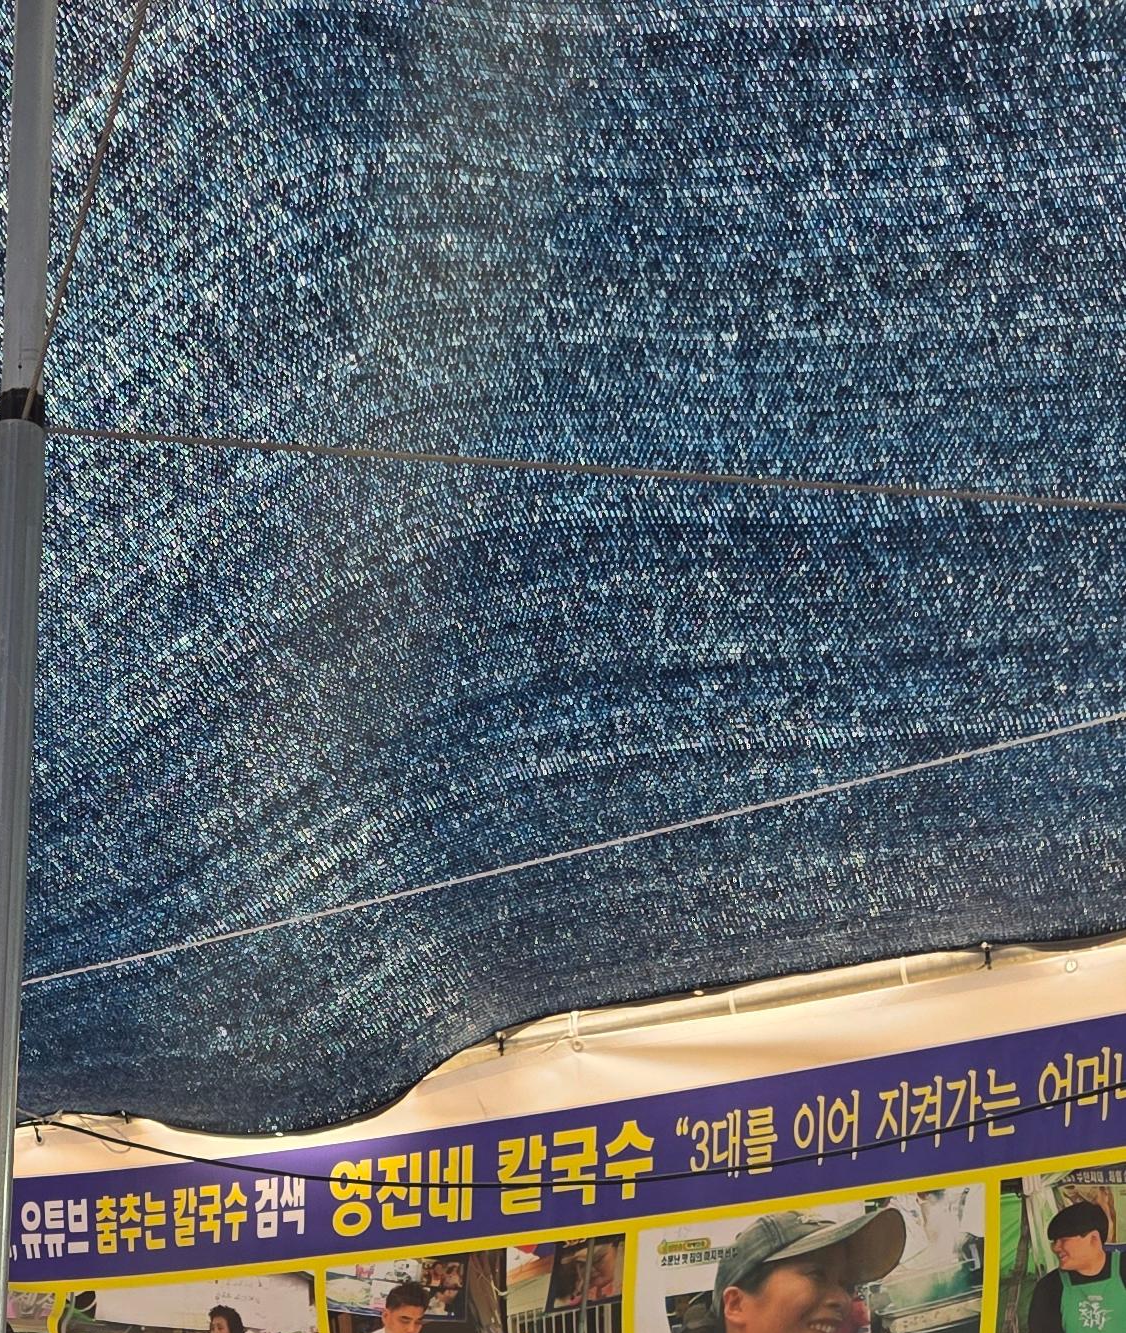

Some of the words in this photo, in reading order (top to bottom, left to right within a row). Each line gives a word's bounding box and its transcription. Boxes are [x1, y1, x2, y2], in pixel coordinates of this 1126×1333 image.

[330, 1143, 473, 1236] 영진네
[498, 1119, 655, 1215] 칼국수
[793, 1090, 861, 1165] 이어
[879, 1068, 1022, 1156] 지켜가는
[21, 1199, 89, 1260] 유튜브
[255, 1176, 306, 1239] 검색
